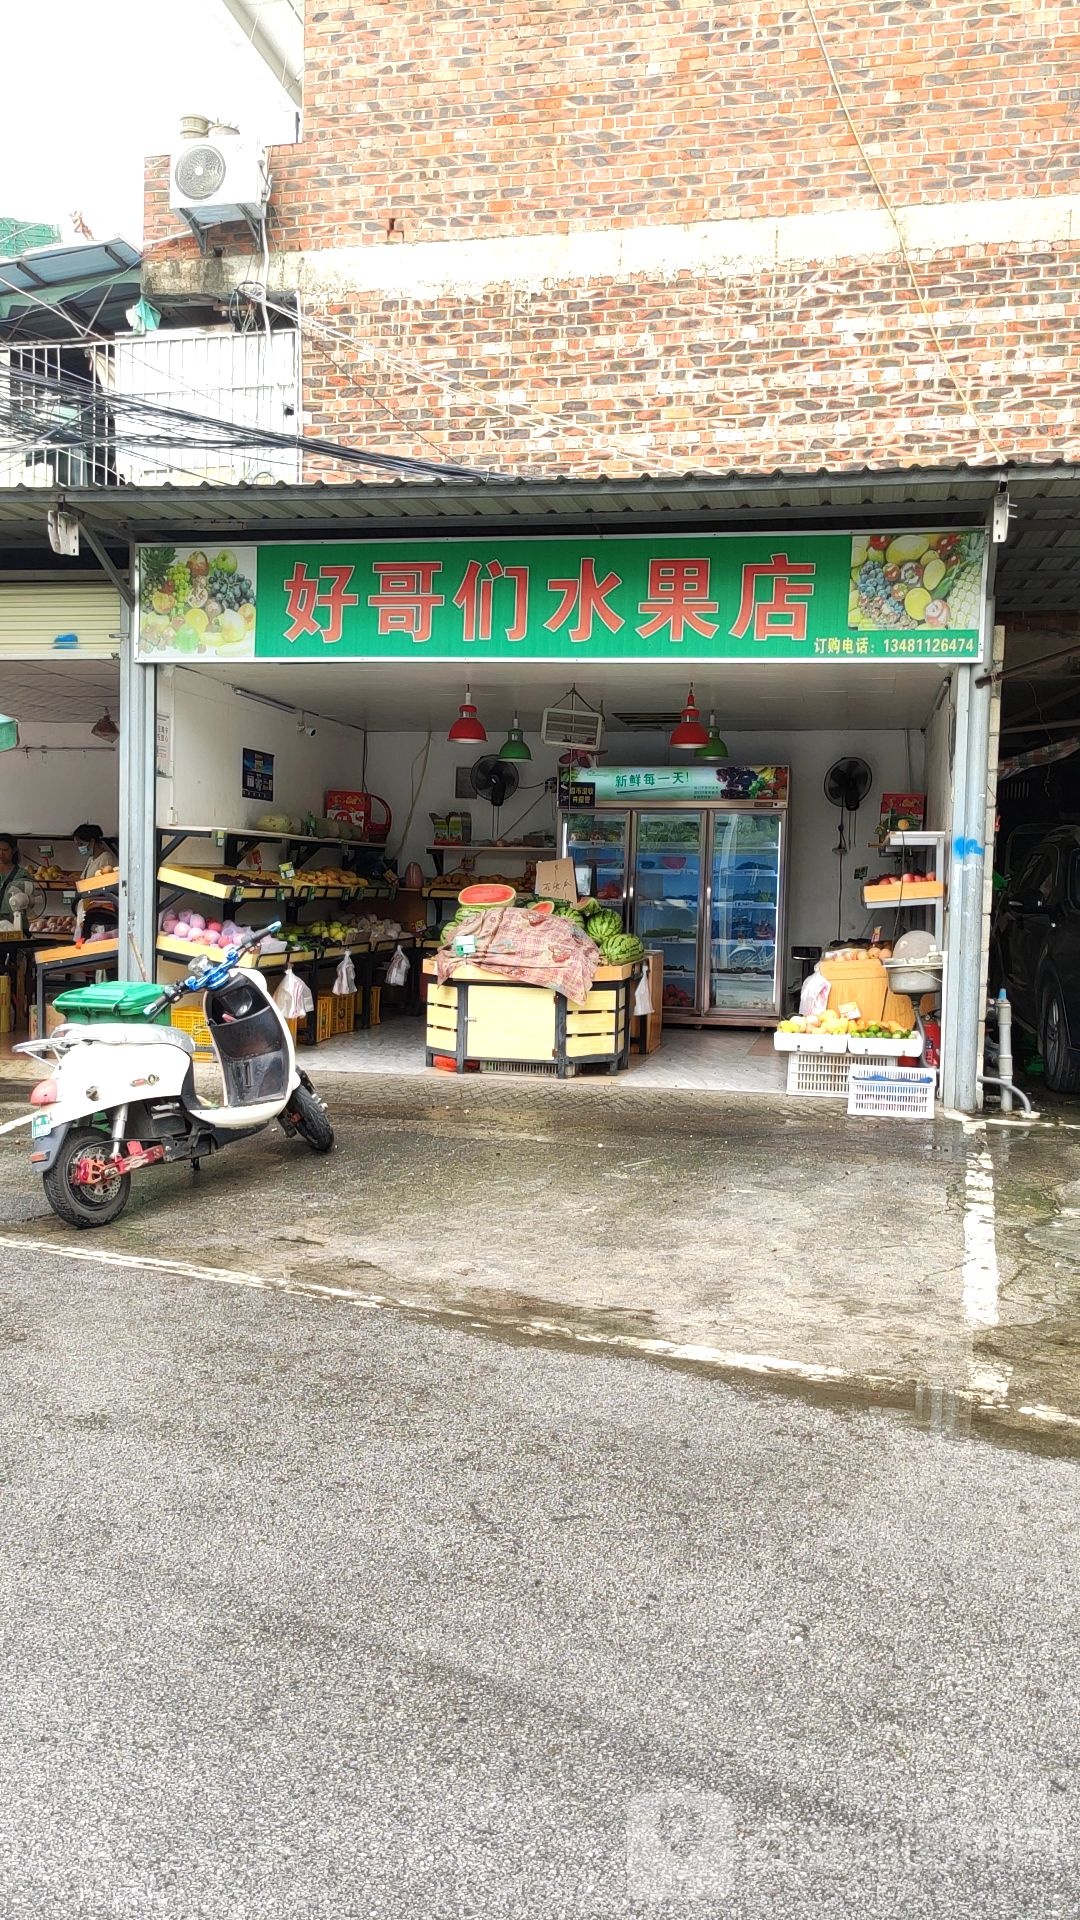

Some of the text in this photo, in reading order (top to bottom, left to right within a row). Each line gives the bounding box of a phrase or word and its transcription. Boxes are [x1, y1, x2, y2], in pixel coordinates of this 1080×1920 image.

[283, 553, 816, 643] 好哥们水果店
[615, 771, 689, 788] 新鲜每一天!
